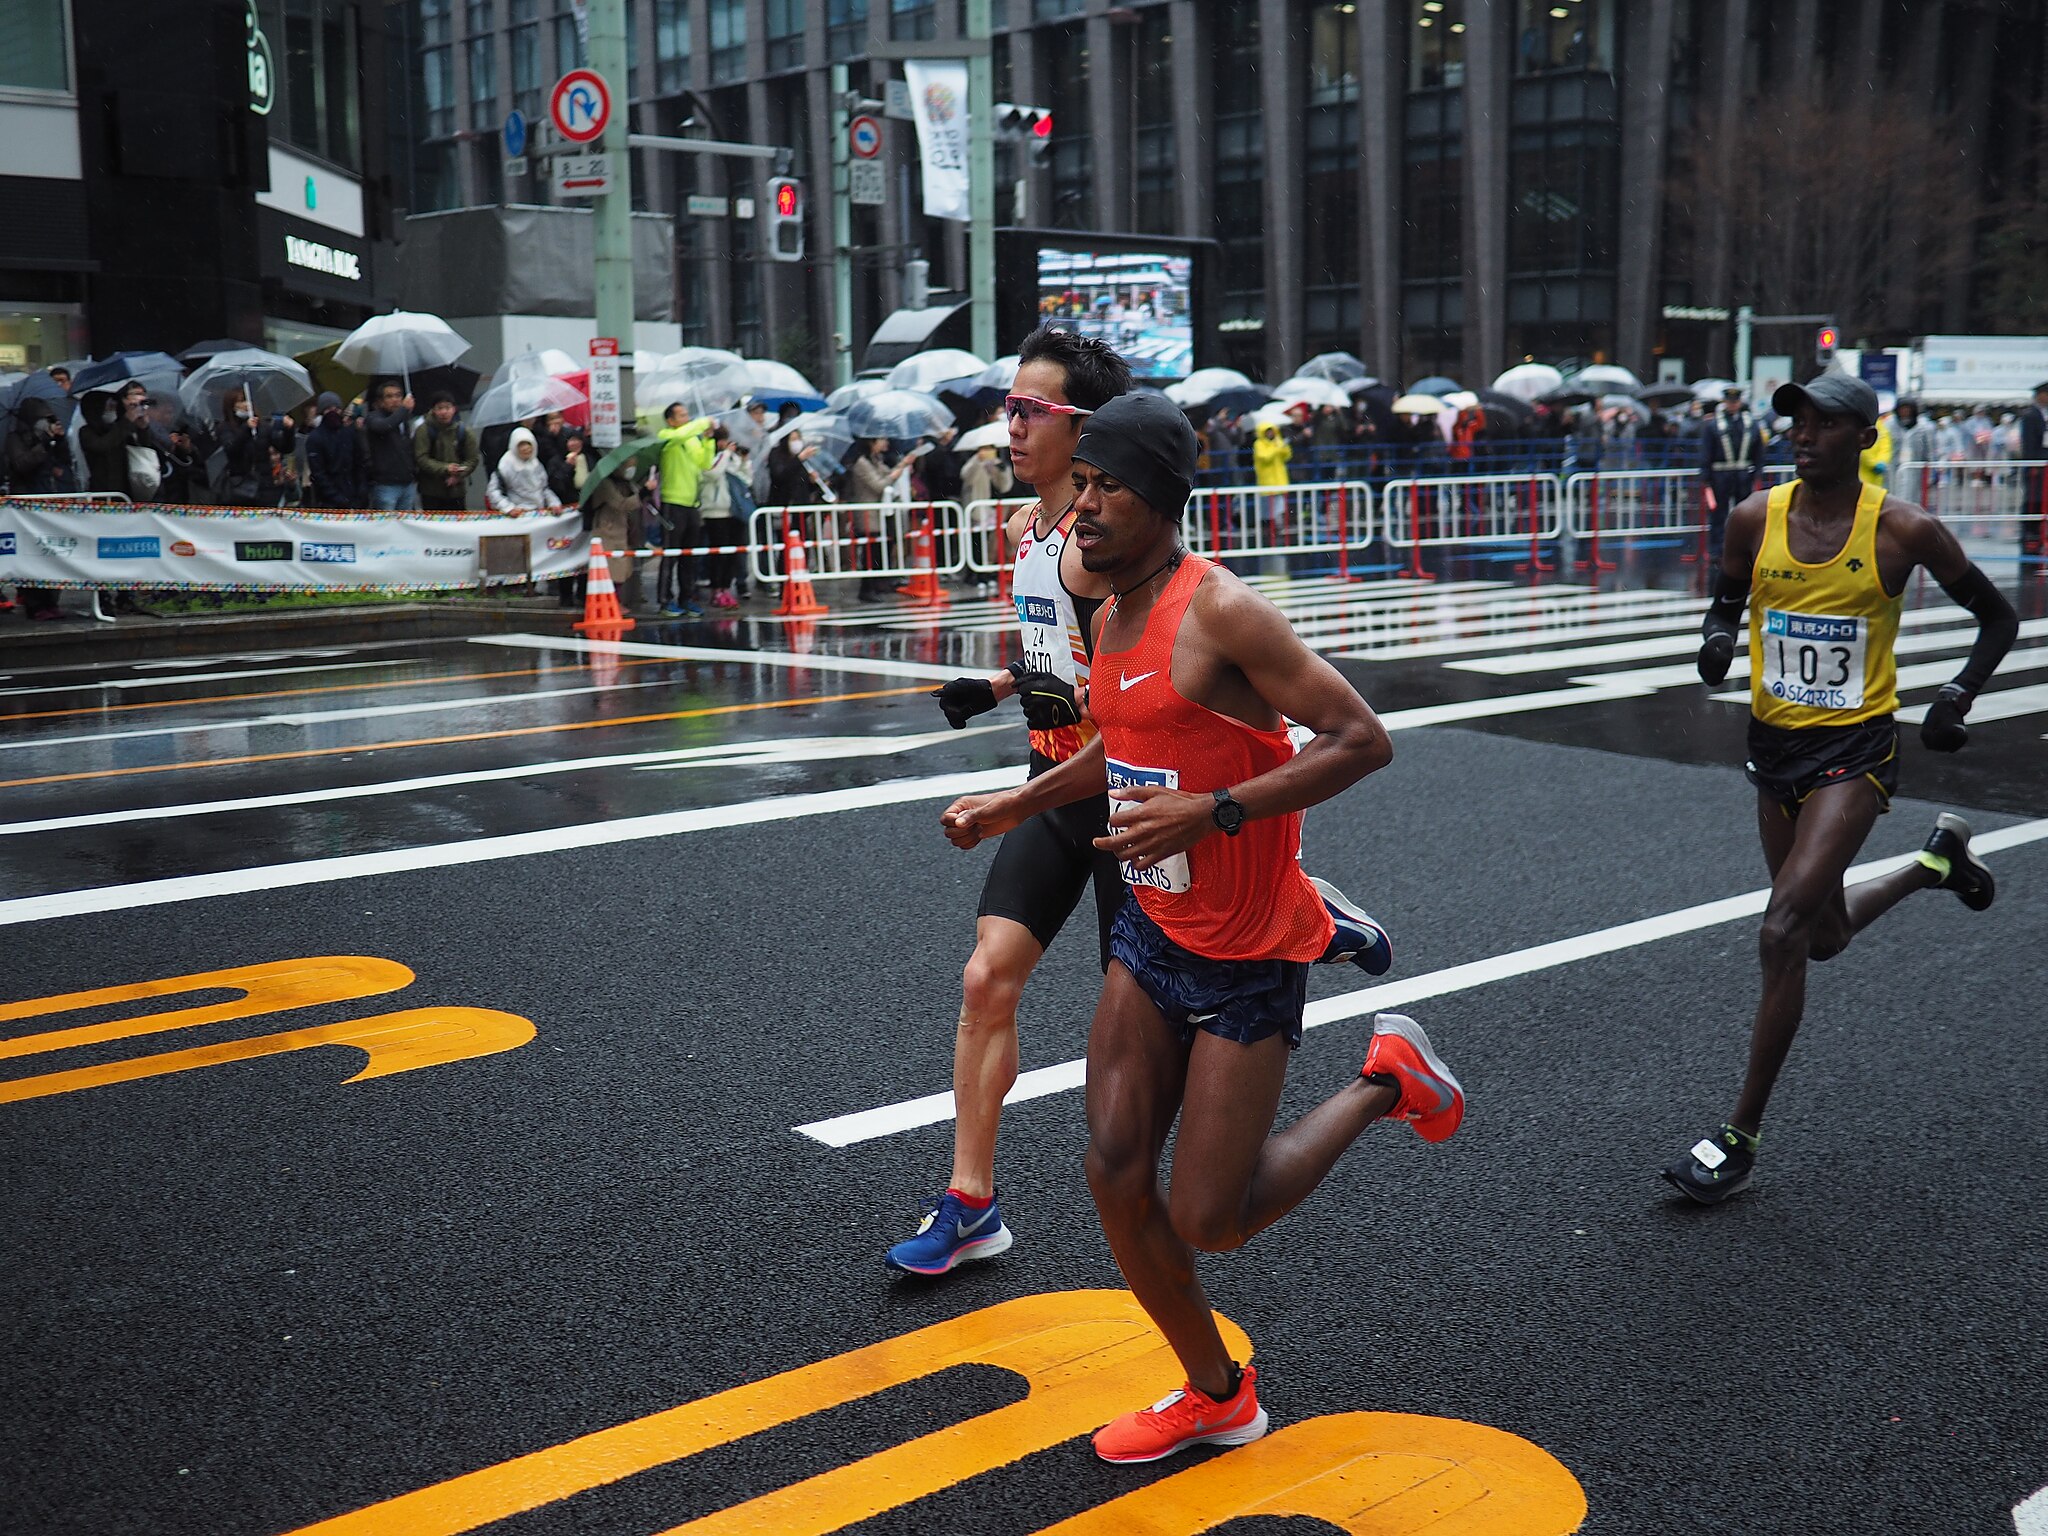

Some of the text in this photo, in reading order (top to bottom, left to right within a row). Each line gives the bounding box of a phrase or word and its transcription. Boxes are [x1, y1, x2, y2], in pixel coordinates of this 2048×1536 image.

[117, 541, 158, 553] ANESSA
[244, 544, 284, 558] hulu
[301, 543, 356, 562] 日本光電
[1027, 602, 1054, 619] 東京メトロ
[1032, 627, 1045, 648] 24
[1790, 621, 1852, 637] 東京メトロ
[1024, 650, 1052, 674] SATO
[1778, 640, 1851, 687] 103
